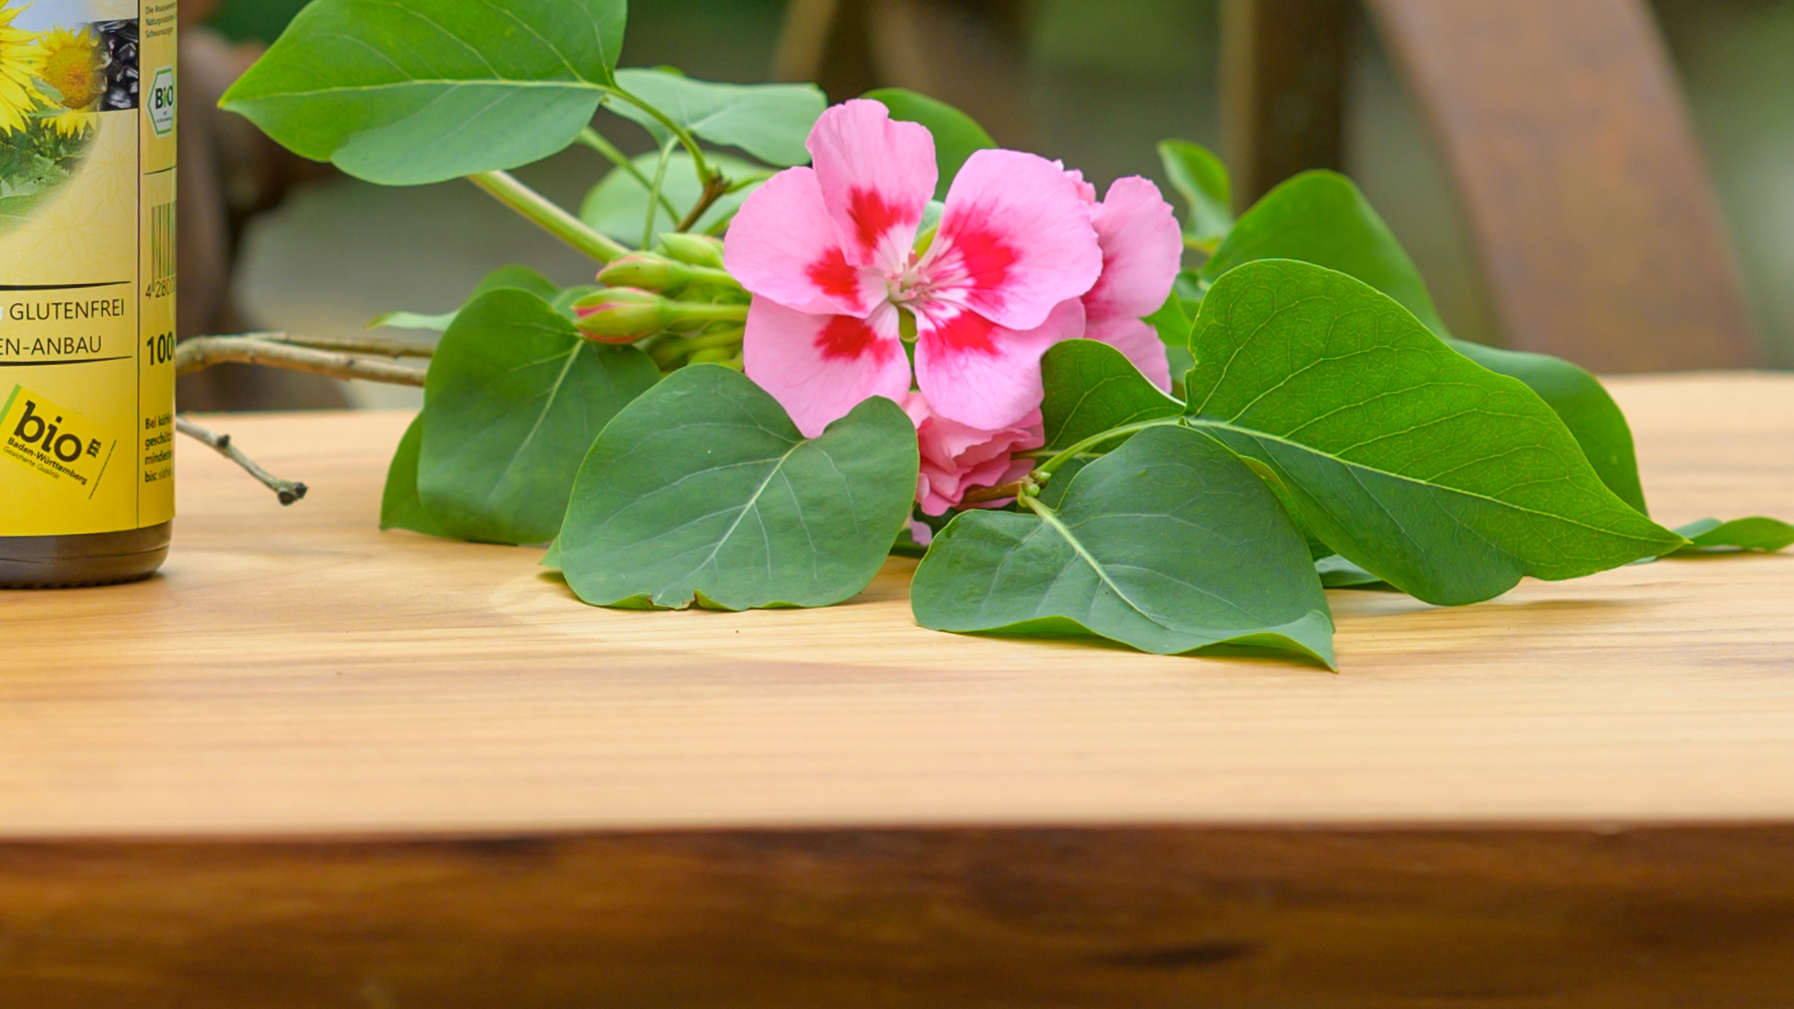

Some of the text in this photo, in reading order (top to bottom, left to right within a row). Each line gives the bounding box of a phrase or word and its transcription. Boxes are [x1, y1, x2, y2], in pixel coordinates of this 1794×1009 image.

[9, 298, 125, 322] GLUTENFREI
[13, 399, 83, 463] bio
[7, 437, 88, 486] Baden-Württemberg
